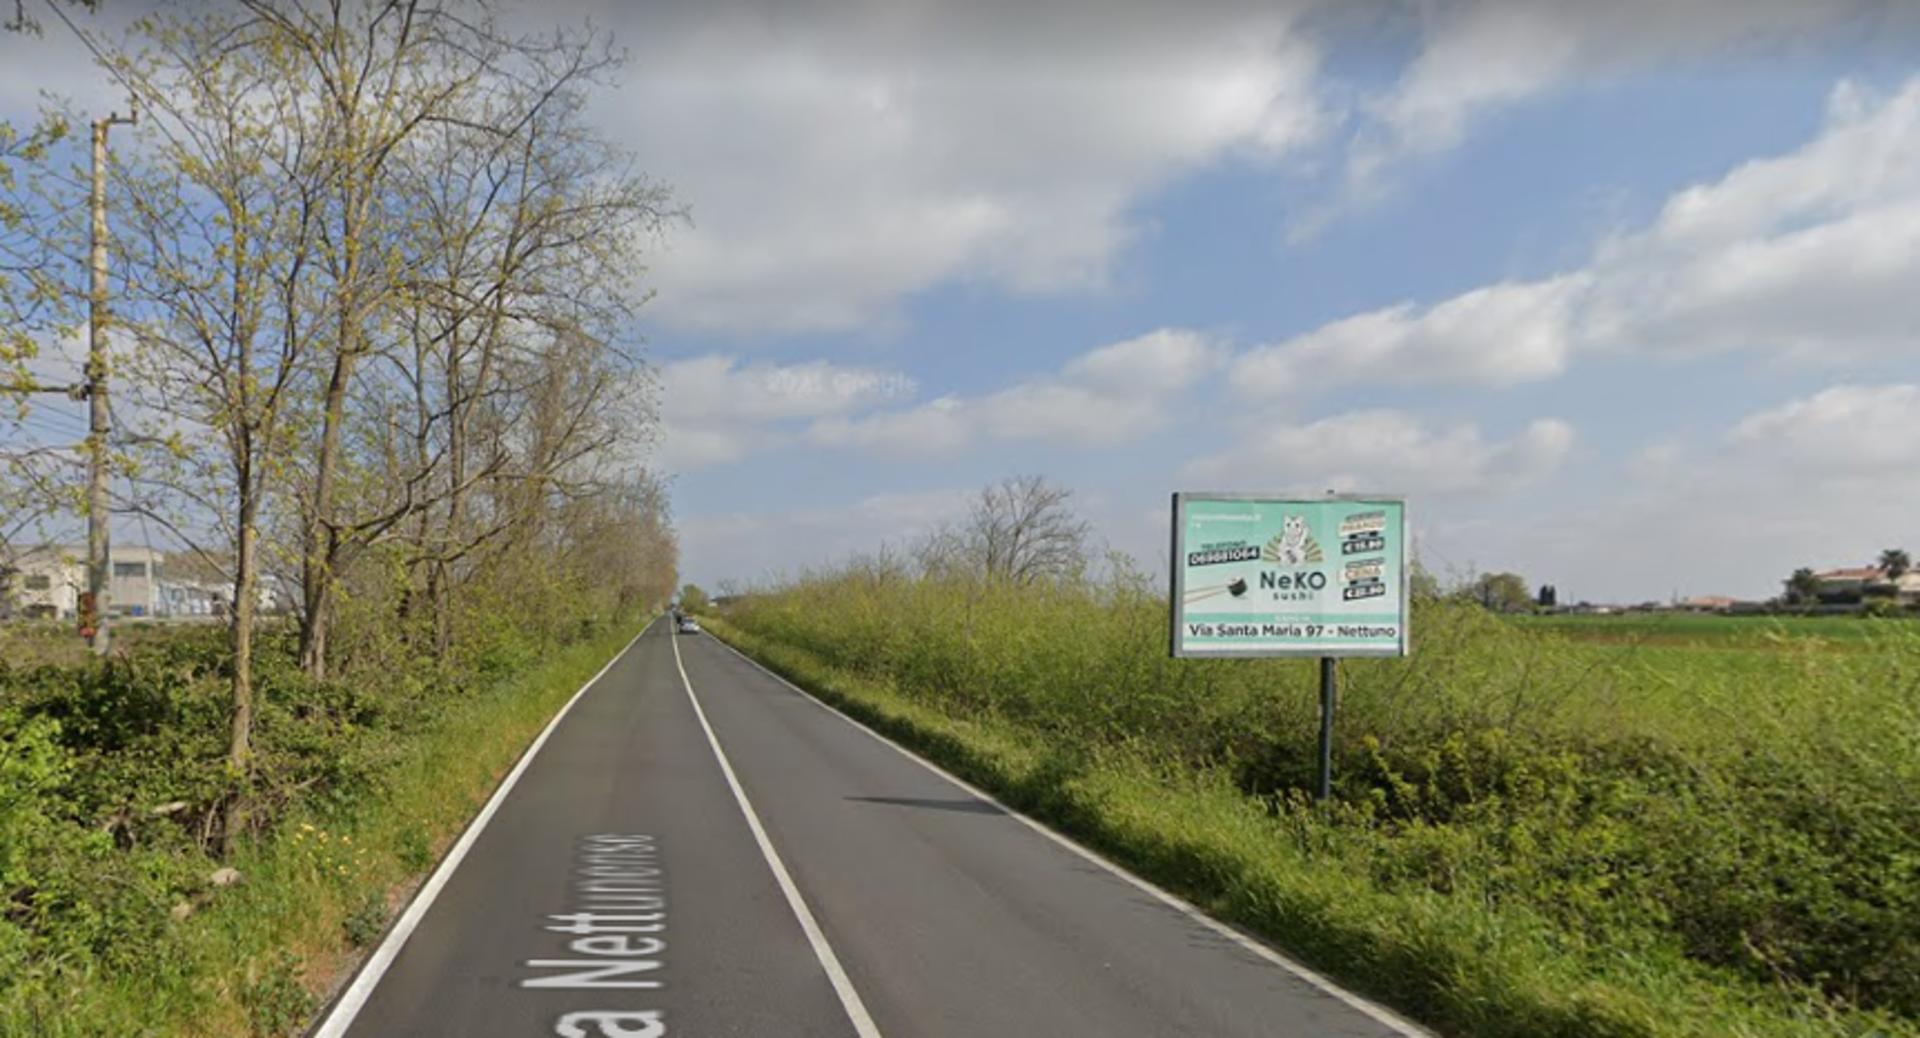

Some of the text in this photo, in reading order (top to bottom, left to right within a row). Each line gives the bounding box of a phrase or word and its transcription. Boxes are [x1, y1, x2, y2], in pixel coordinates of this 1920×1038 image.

[1273, 591, 1314, 601] sushi
[1189, 624, 1213, 637] Via
[1217, 623, 1258, 638] Santa
[1262, 624, 1301, 638] Maria
[1306, 624, 1324, 637] 97
[1337, 625, 1397, 638] Nettuno
